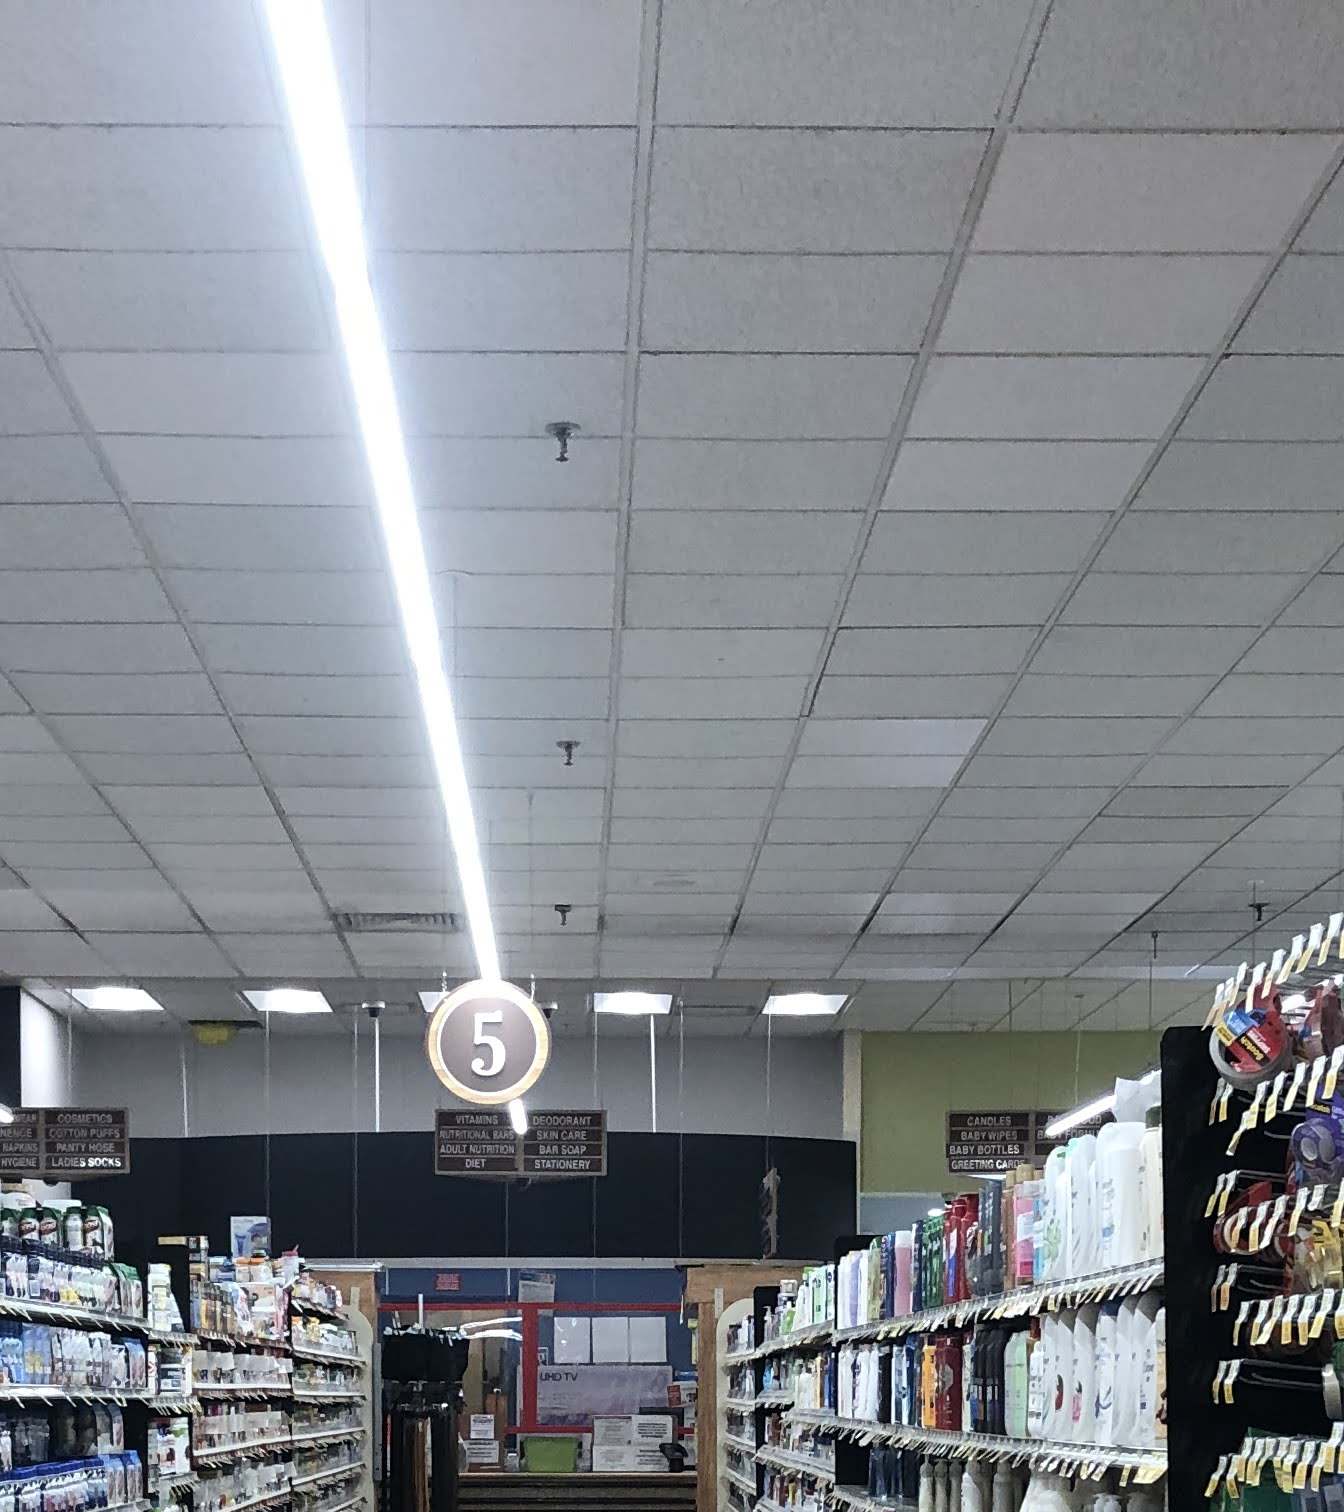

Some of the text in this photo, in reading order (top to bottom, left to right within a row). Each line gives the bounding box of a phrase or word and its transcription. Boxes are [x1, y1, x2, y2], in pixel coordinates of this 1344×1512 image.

[471, 1010, 506, 1077] 5
[1240, 1037, 1265, 1061] Scotch
[57, 1113, 113, 1123] COSMETICS
[456, 1115, 498, 1125] VITAMINS
[532, 1116, 592, 1126] DEODORANT
[967, 1116, 1012, 1126] CANDLES
[49, 1128, 120, 1139] COTTON PUFFS
[440, 1130, 515, 1140] NUTRITIONAL BARS
[536, 1131, 587, 1141] SKIN CARE
[960, 1130, 1018, 1141] BABY WIPES
[3, 1143, 38, 1152] NAPKINS
[56, 1142, 115, 1152] PANTY HOSE
[440, 1144, 515, 1155] ADULT NUTRITION
[539, 1145, 587, 1155] BAR SOAP
[949, 1144, 1020, 1156] BABY BOTTLES
[2, 1157, 37, 1167] HYGIENE
[52, 1157, 122, 1167] LADIES SOCKS
[465, 1158, 487, 1169] DIET
[534, 1159, 591, 1170] STATIONERY
[951, 1160, 994, 1170] GREETING
[564, 1372, 578, 1381] TV
